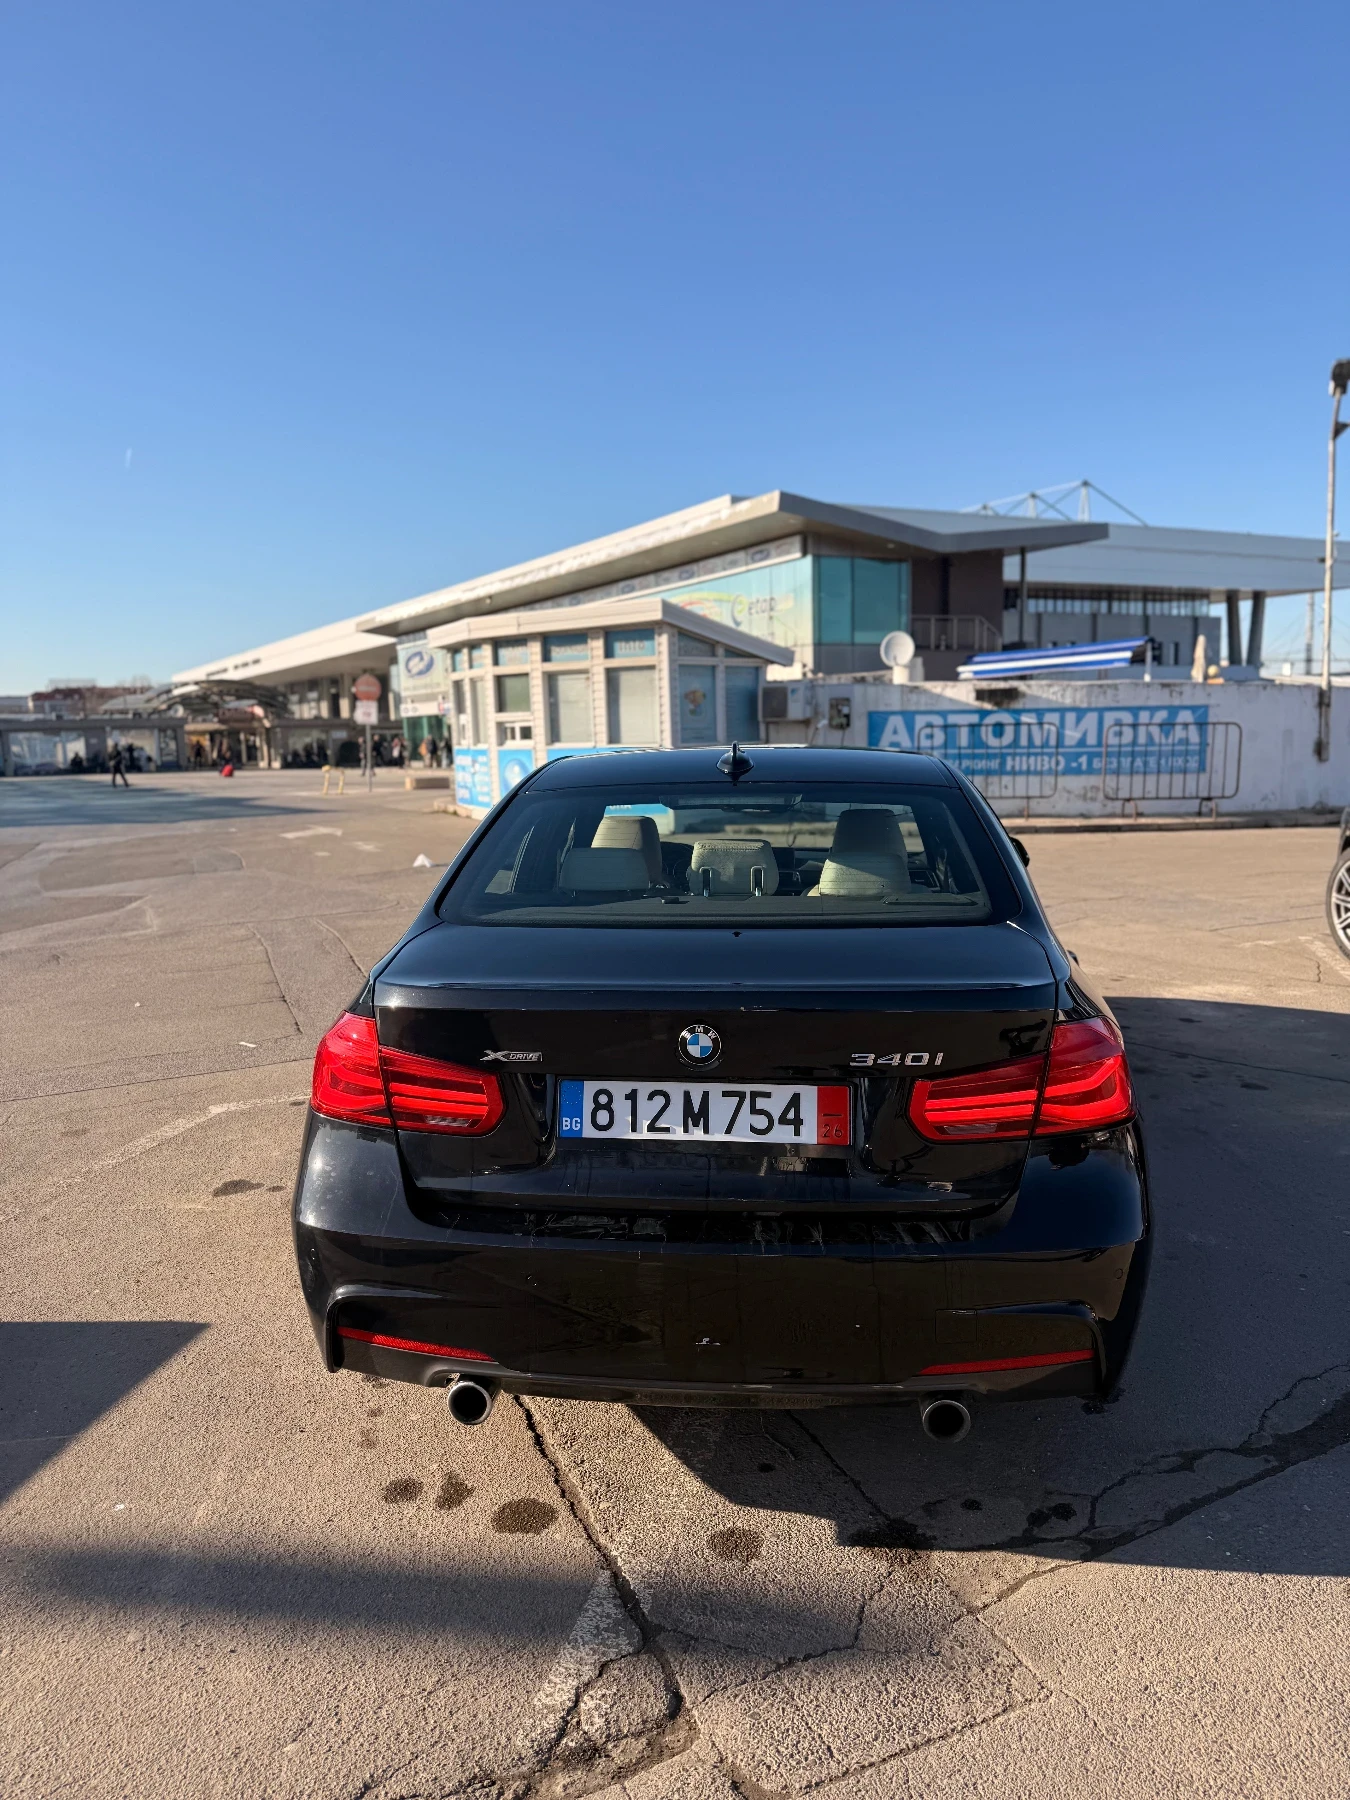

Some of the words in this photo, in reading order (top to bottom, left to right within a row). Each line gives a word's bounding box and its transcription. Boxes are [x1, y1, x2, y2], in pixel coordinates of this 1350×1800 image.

[878, 709, 1201, 748] АВТОМИВКА
[1006, 755, 1065, 772] НИВО
[562, 1117, 581, 1131] BG
[822, 1123, 843, 1138] 26
